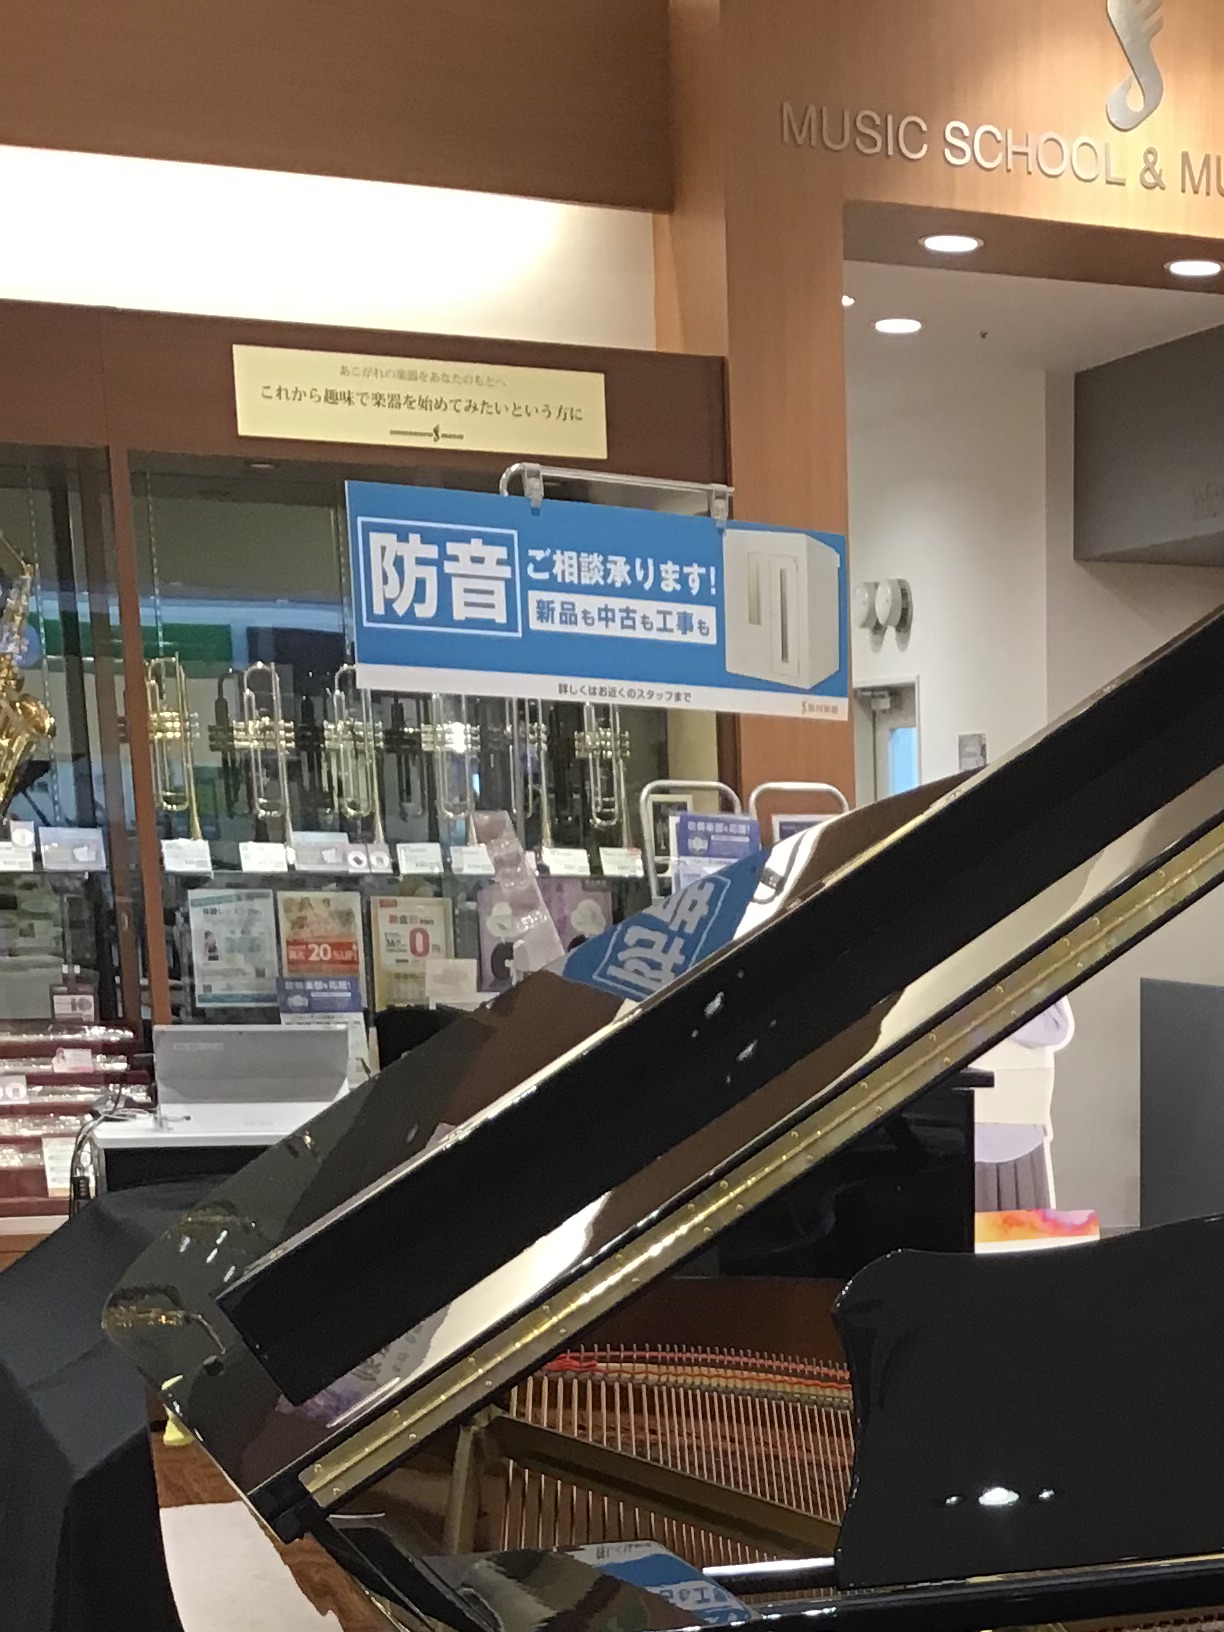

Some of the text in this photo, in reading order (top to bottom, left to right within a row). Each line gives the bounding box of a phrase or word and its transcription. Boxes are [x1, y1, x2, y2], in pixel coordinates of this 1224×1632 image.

[780, 102, 929, 160] MUSIC
[943, 120, 1127, 186] SCHOOL
[1139, 147, 1166, 190] &
[260, 384, 584, 422] これから趣味で楽器を始めてみたいという方に
[368, 531, 513, 625] 防音
[527, 547, 718, 596] ご相談承ります!
[535, 598, 712, 637] 新品も中古も工事も
[558, 683, 692, 704] 詳しくはお近くのスタッフまで
